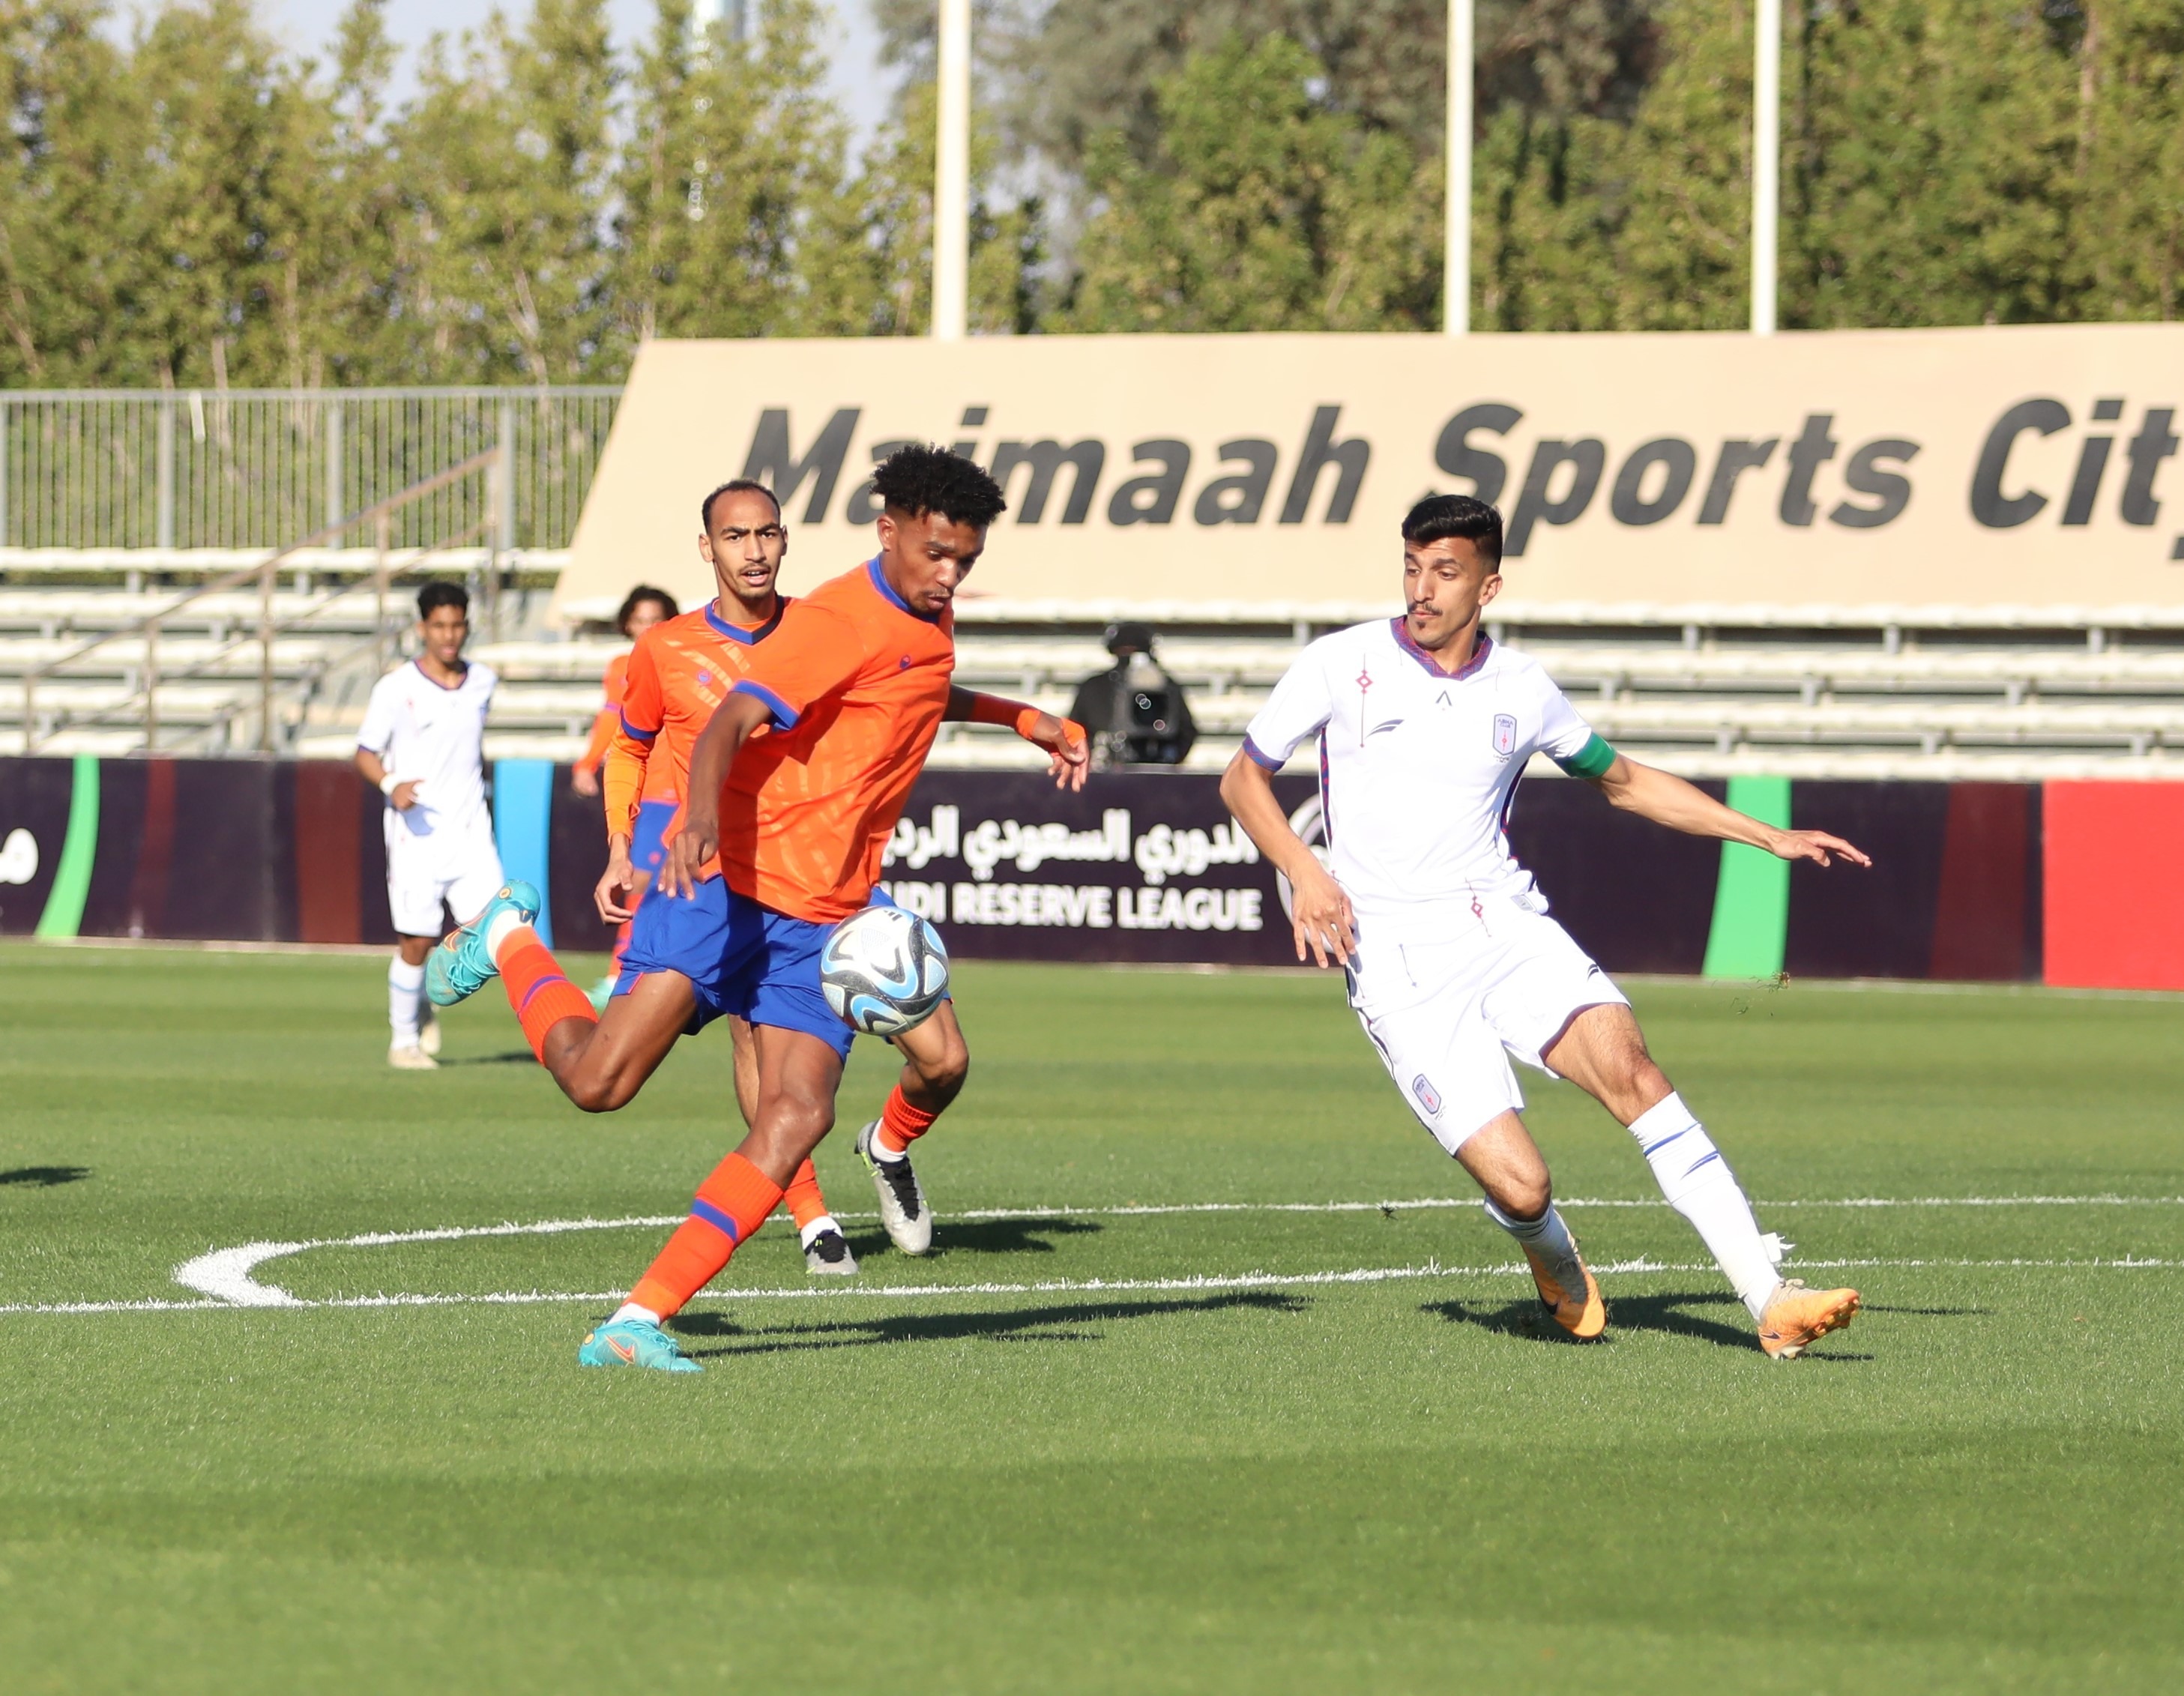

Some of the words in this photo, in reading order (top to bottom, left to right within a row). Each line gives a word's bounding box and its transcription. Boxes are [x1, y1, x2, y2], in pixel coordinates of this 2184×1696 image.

[1408, 403, 1922, 556] Sports
[1970, 398, 2184, 560] Cit
[962, 808, 1132, 882] السعودي
[951, 881, 1113, 930] RESERVE
[1116, 886, 1264, 932] LEAGUE
